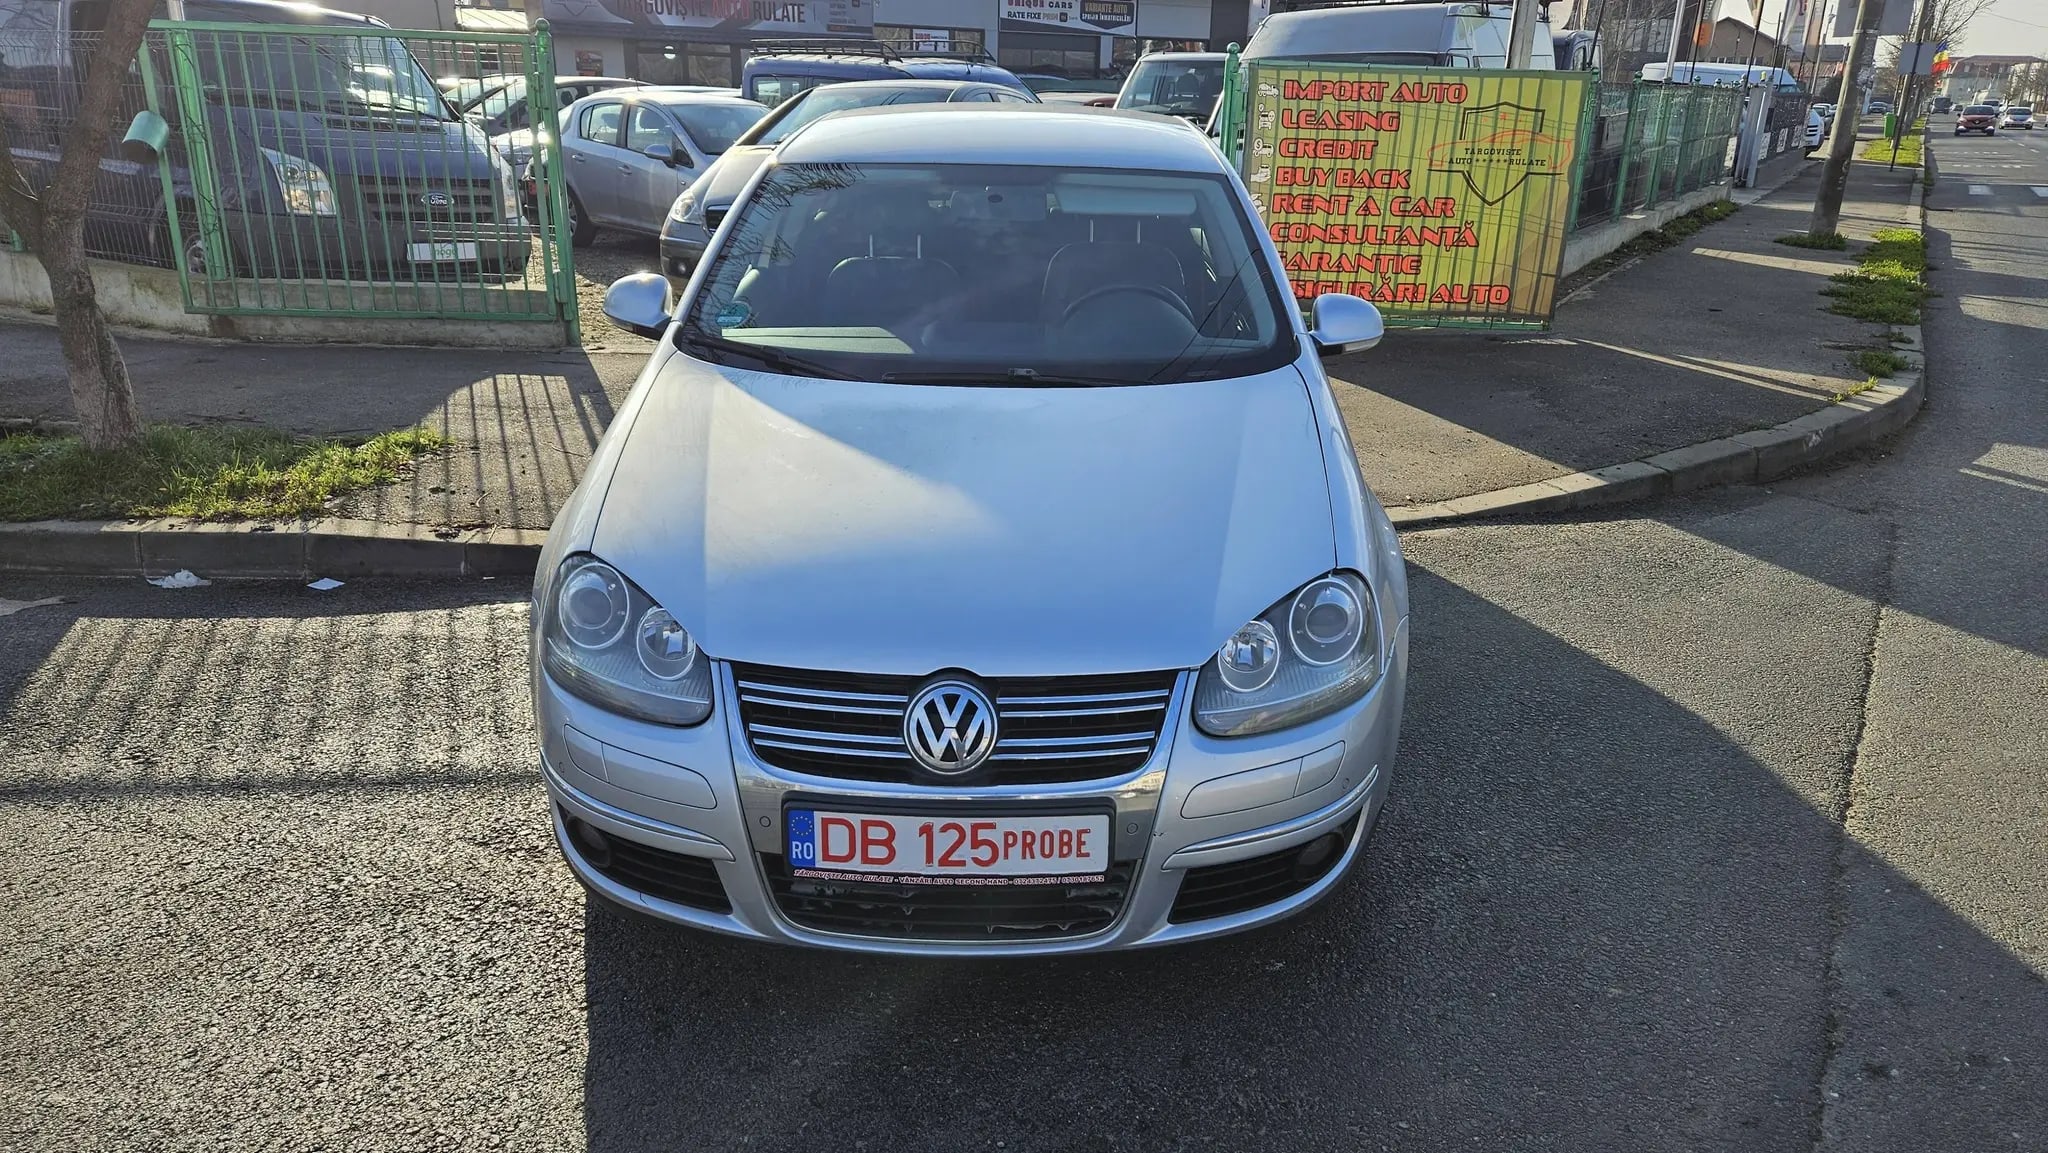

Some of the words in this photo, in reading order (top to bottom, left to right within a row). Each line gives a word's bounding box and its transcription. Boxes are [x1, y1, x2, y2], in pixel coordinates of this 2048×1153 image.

[752, 1, 806, 22] RULATE
[1007, 11, 1025, 19] RATE
[1026, 11, 1042, 20] FIXE
[1048, 1, 1073, 9] CARS
[1283, 80, 1389, 102] IMPORT
[1390, 82, 1469, 104] AUTO
[1281, 108, 1401, 132] LEASING
[1279, 138, 1379, 160] CREDIT
[1464, 148, 1522, 156] TARGOVISTE
[1448, 157, 1473, 165] AUTO
[1509, 158, 1547, 167] RULATE
[1275, 166, 1333, 187] BUY
[1334, 168, 1412, 189] BACK
[1272, 193, 1354, 216] RENT
[1355, 196, 1382, 217] A
[1389, 197, 1456, 218] CAR
[1269, 220, 1480, 251] CONSULTANȚĂ
[1281, 251, 1423, 278] ARANȚIE
[1288, 276, 1427, 304] SIGURĂRI
[1429, 283, 1512, 305] AUTO
[908, 690, 990, 768] VW
[791, 841, 814, 860] RO
[820, 816, 897, 866] DB
[918, 821, 1000, 868] 125
[1003, 828, 1091, 860] PROBE
[840, 873, 863, 882] AUTO
[863, 874, 894, 883] RULATE
[932, 877, 954, 886] AUTO
